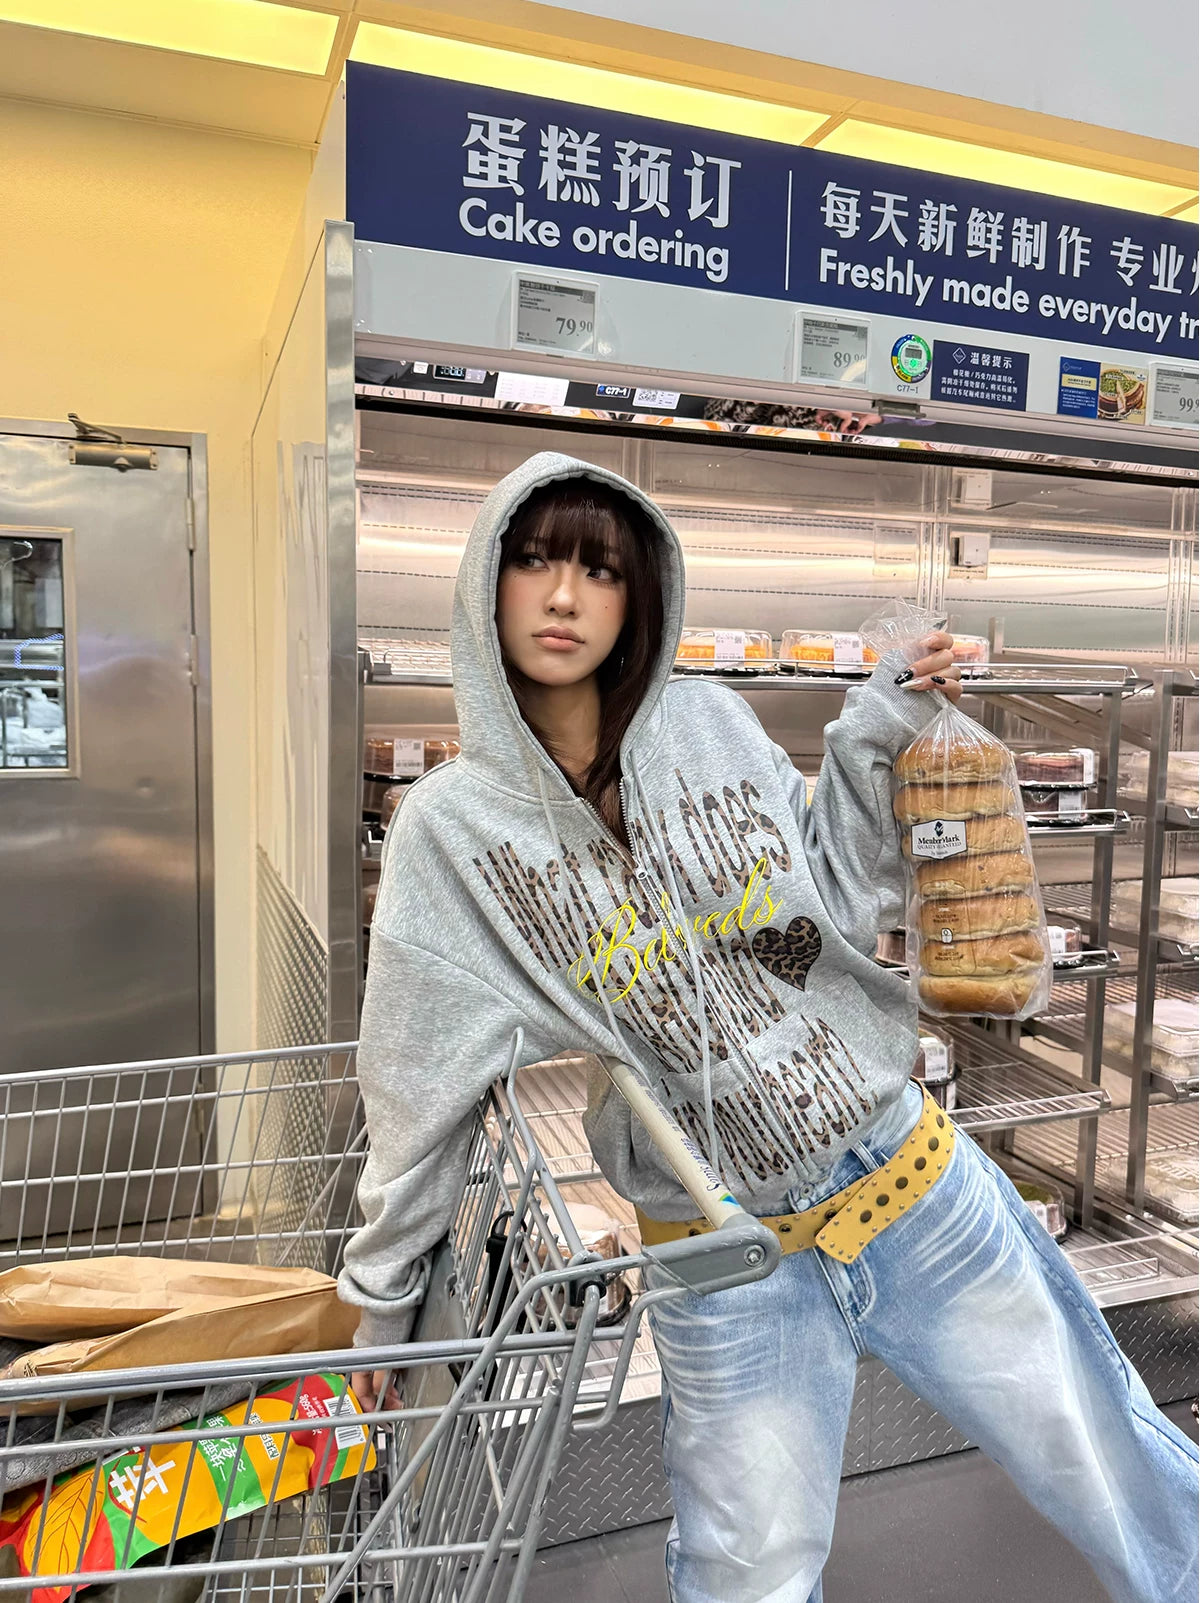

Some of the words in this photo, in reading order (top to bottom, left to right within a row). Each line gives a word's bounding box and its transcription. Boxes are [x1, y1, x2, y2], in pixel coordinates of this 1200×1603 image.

[461, 112, 742, 229] 蛋糕预订
[458, 197, 561, 248] Cake
[572, 220, 730, 283] ordering
[820, 181, 1092, 278] 每天新鲜制作
[556, 317, 593, 336] 79.90
[819, 248, 935, 306] Freshly
[942, 276, 1030, 313] made
[1039, 297, 1173, 343] everyday
[604, 386, 627, 396] C77-1
[897, 384, 919, 394] C77-1
[970, 352, 1012, 369] 温馨提示
[674, 767, 792, 898] does
